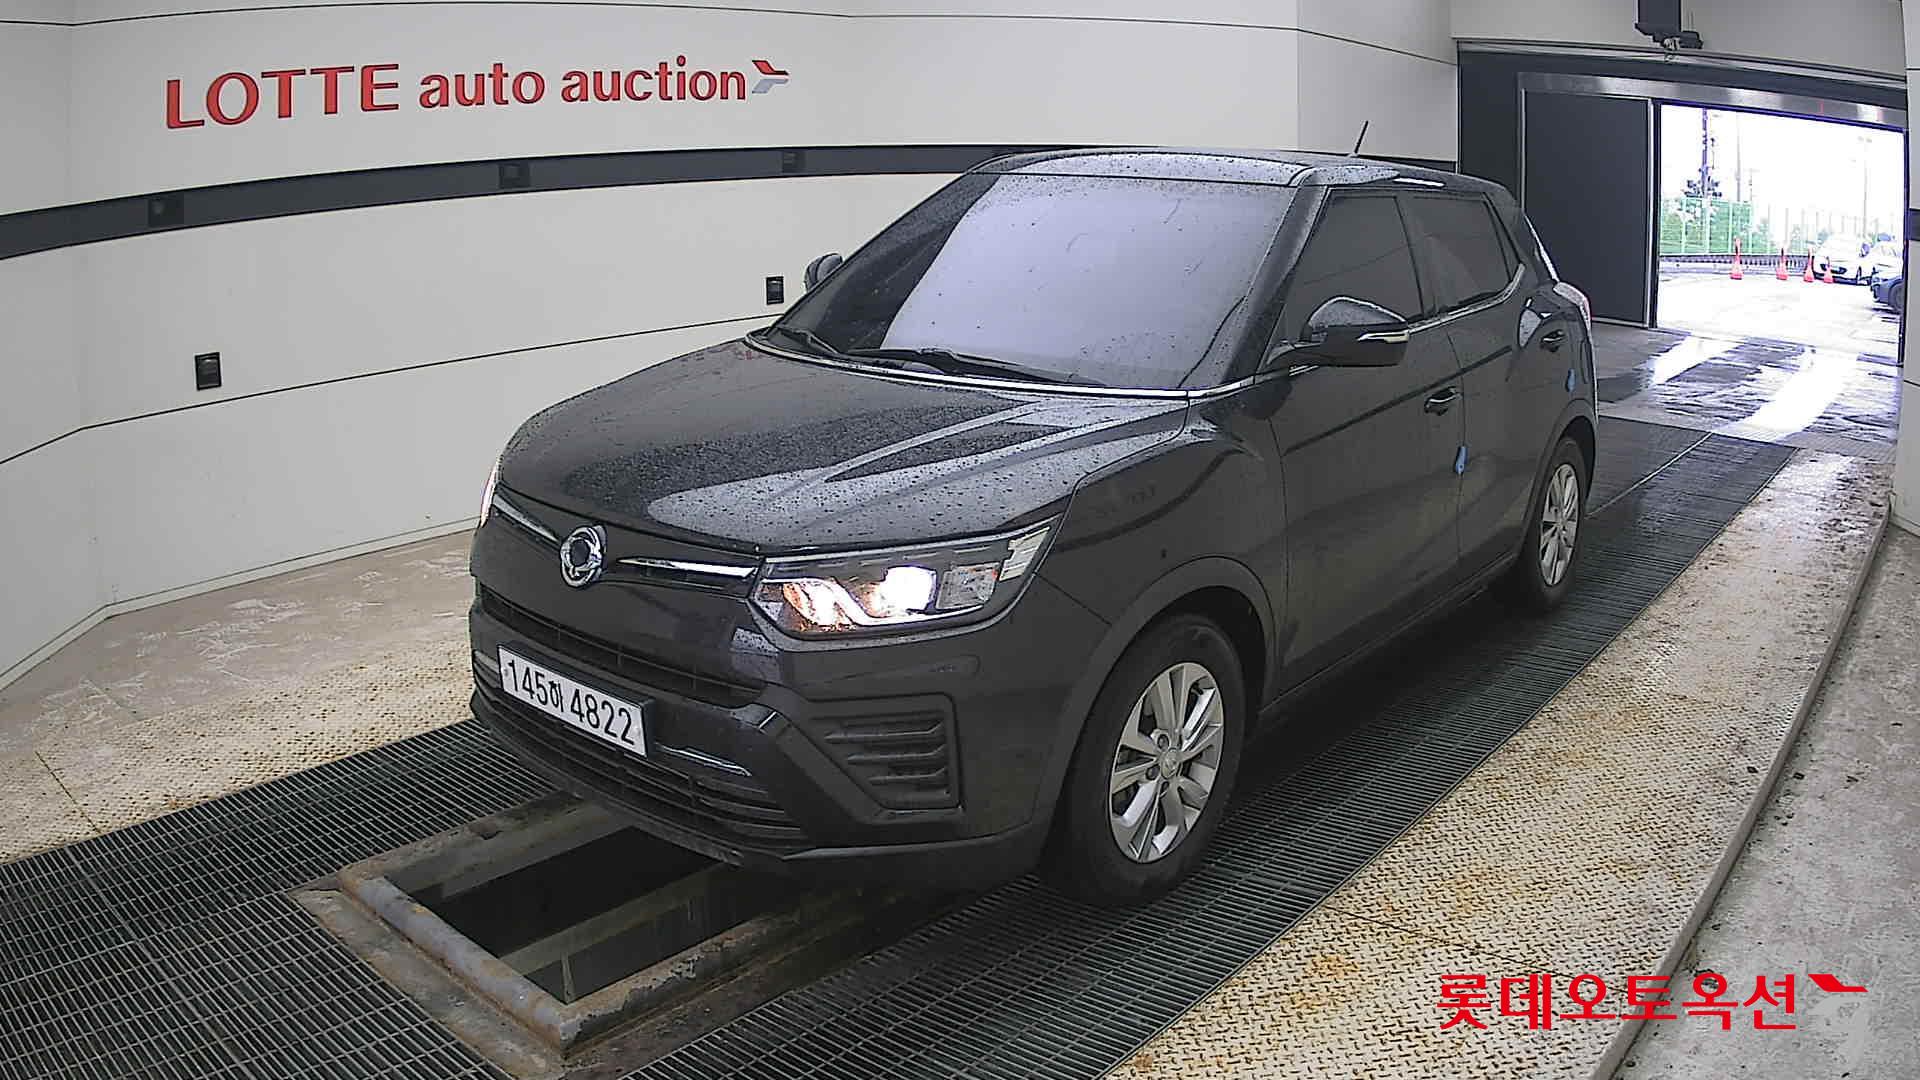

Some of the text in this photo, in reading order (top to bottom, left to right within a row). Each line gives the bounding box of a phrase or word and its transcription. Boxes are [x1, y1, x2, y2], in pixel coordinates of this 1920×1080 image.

[166, 53, 747, 130] LOTTE auto auction
[570, 688, 635, 746] 4822
